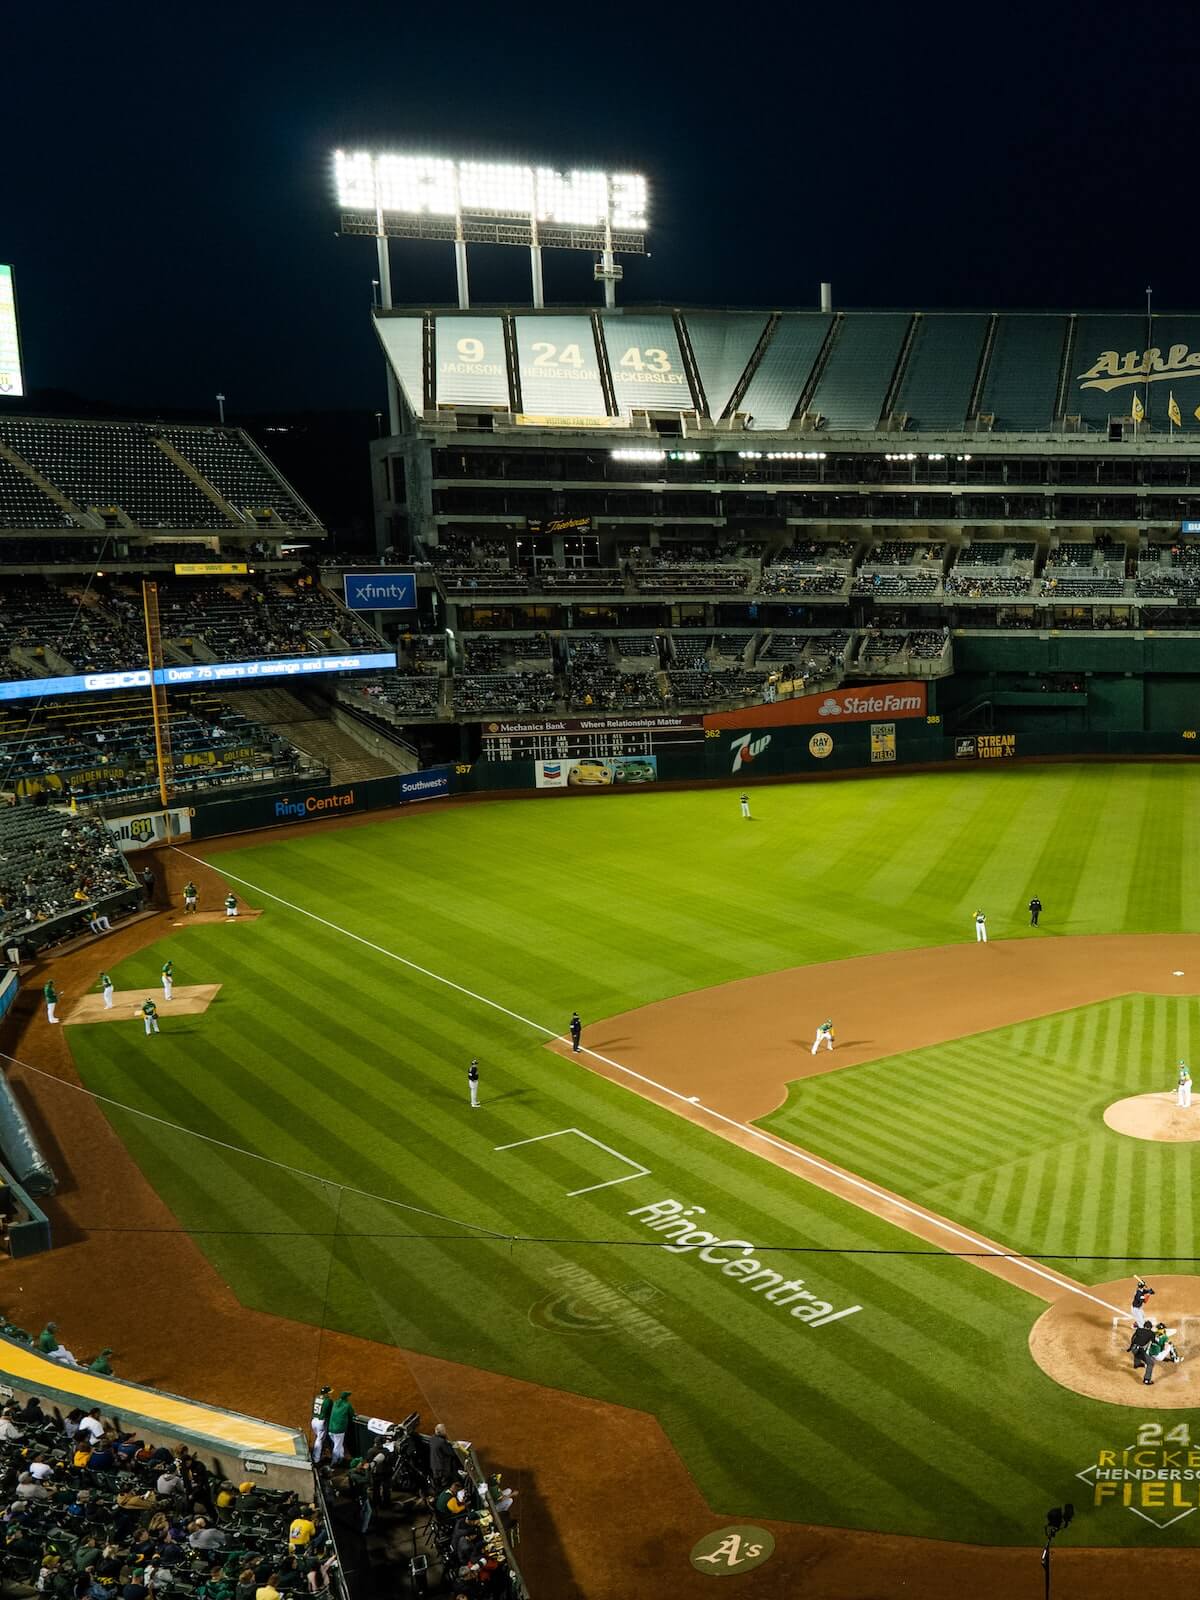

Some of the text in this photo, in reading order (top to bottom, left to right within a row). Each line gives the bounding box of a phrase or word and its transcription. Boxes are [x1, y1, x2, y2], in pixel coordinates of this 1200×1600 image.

[456, 338, 485, 363] 9
[531, 342, 585, 368] 24
[619, 347, 672, 373] 43
[440, 362, 501, 376] JACKSON
[523, 368, 599, 381] HENDERSON
[614, 372, 684, 385] ECKERSLEY
[356, 583, 407, 601] xfinity
[85, 657, 360, 690] GEICO Over 75 years of savings and service
[843, 696, 921, 715] State Farm
[501, 721, 566, 732] Mechanics Bank
[580, 717, 682, 729] Where Relationships Matter
[705, 729, 720, 738] 362
[1182, 731, 1197, 739] 400
[813, 738, 829, 747] RAY
[978, 735, 1016, 747] STREAM
[872, 751, 894, 759] FIELD
[978, 747, 1002, 758] YOUR
[402, 779, 441, 793] Southwest
[275, 790, 354, 816] RingCentral
[112, 818, 153, 842] all 811
[627, 1198, 864, 1328] RingCentral
[313, 1403, 323, 1415] 51
[1136, 1422, 1191, 1447] 24
[695, 1534, 764, 1567] A's
